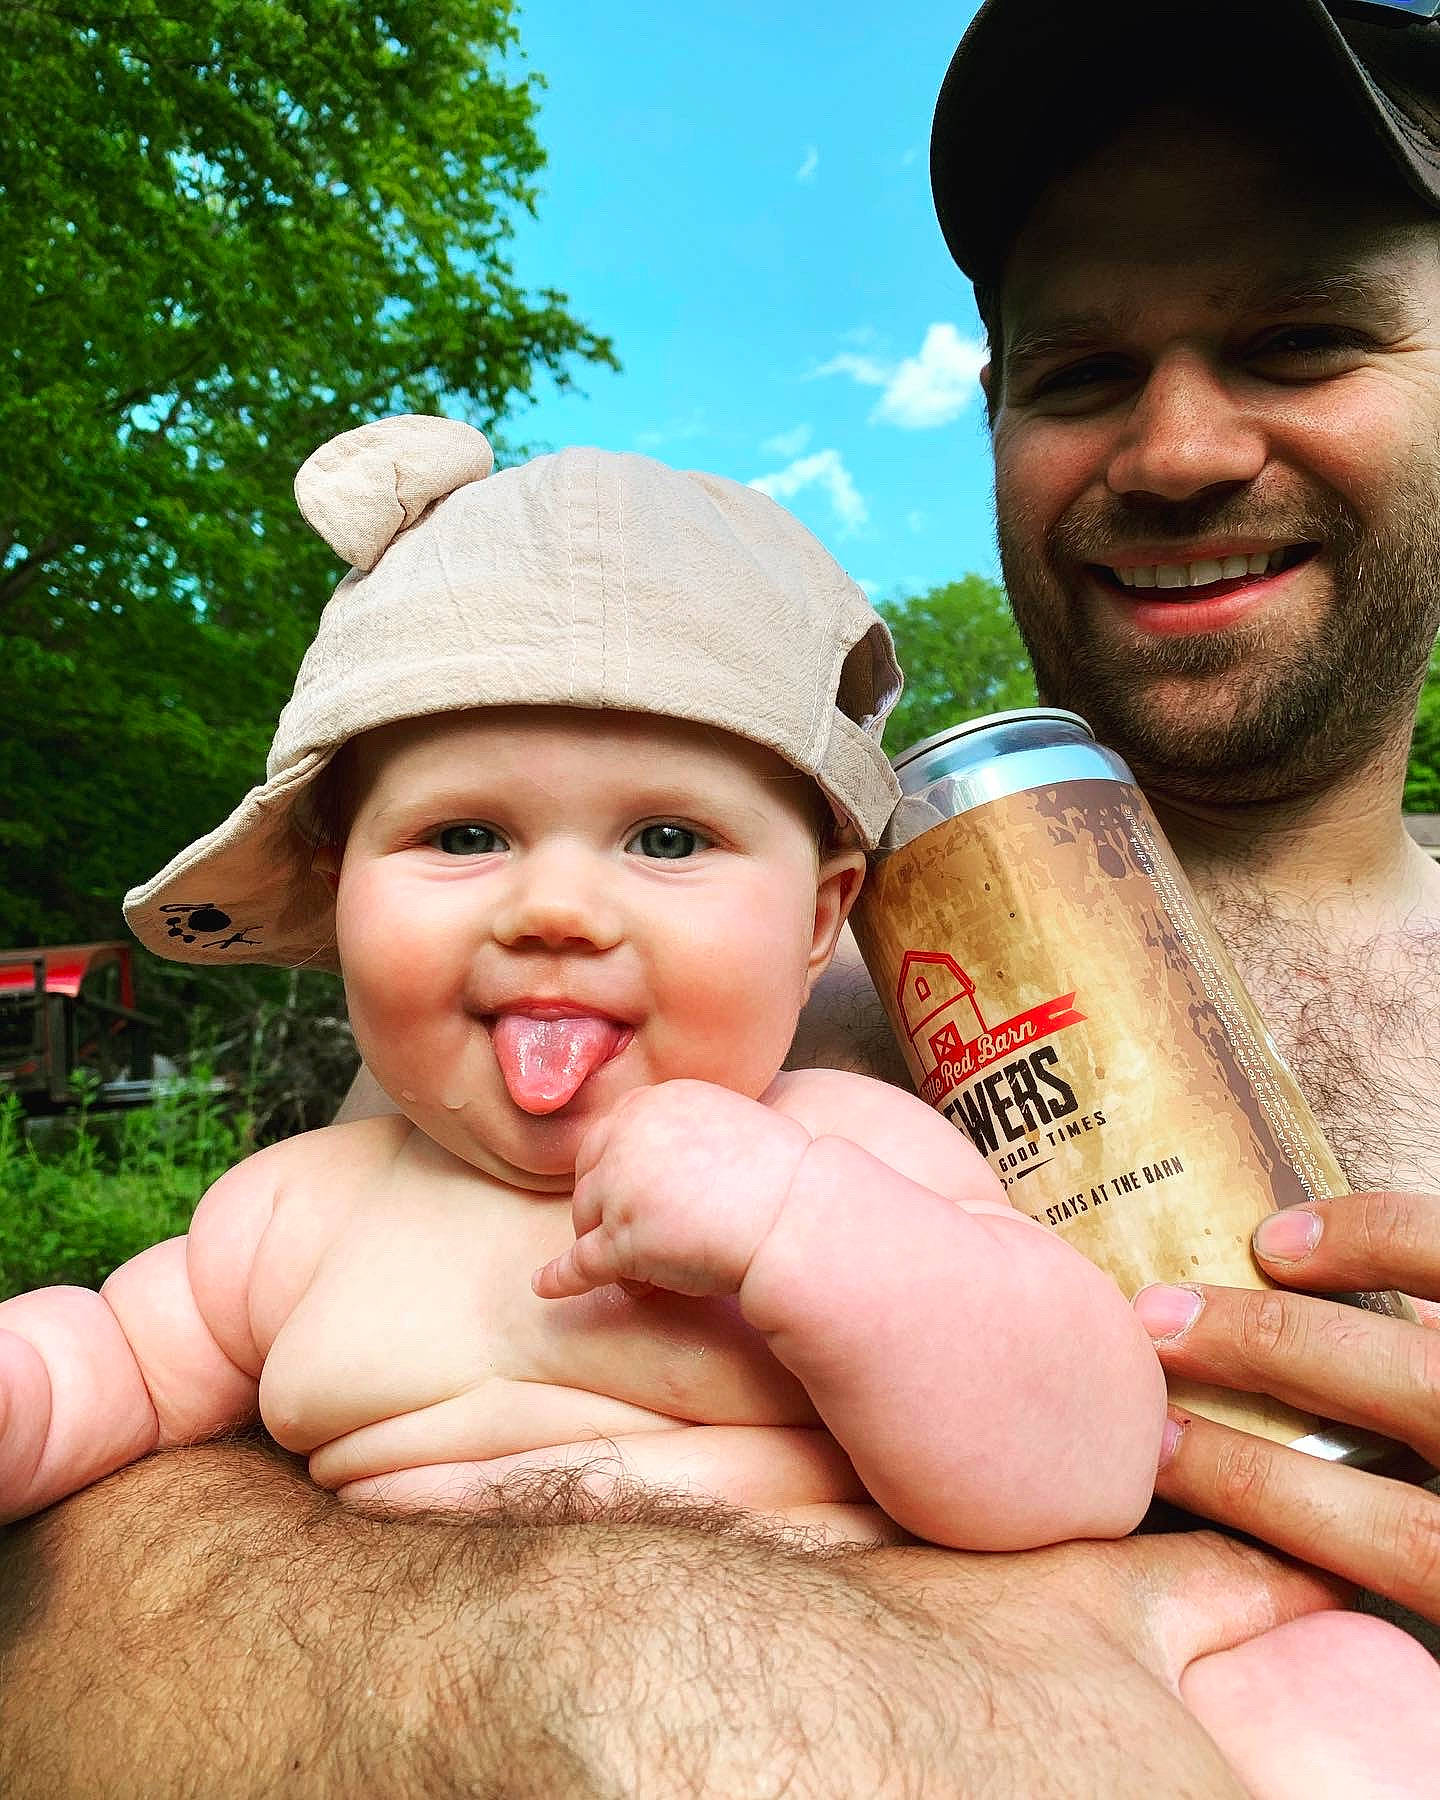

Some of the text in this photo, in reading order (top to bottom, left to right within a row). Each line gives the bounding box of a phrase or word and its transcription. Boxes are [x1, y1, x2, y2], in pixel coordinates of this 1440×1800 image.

[1123, 809, 1148, 849] alcoholic
[1129, 837, 1146, 861] drink
[1143, 863, 1156, 879] not
[1150, 881, 1173, 914] should
[1171, 917, 1192, 953] women
[1185, 931, 1198, 944] (2)
[1196, 933, 1209, 952] may
[1207, 956, 1221, 975] and
[1189, 957, 1216, 998] General,
[1216, 988, 1231, 1011] birth
[1212, 1002, 1239, 1045] Surgeon
[1227, 1015, 1238, 1025] of
[1236, 1028, 1249, 1045] risk
[940, 1050, 975, 1088] Red
[977, 1020, 1038, 1064] Barn
[1235, 1049, 1249, 1066] the
[1247, 1048, 1259, 1065] the
[1250, 1035, 1273, 1076] operate
[1247, 1069, 1256, 1080] to
[1254, 1068, 1266, 1079] of
[1252, 1083, 1286, 1139] According
[1262, 1083, 1290, 1128] because
[1279, 1094, 1290, 1110] car
[998, 1110, 1107, 1173] GOOD TIMES
[1292, 1122, 1310, 1150] drive
[1281, 1142, 1296, 1158] (1)
[1288, 1131, 1323, 1191] pregnancy
[1309, 1153, 1317, 1164] to
[1045, 1155, 1185, 1226] STAYS AT THE BARN
